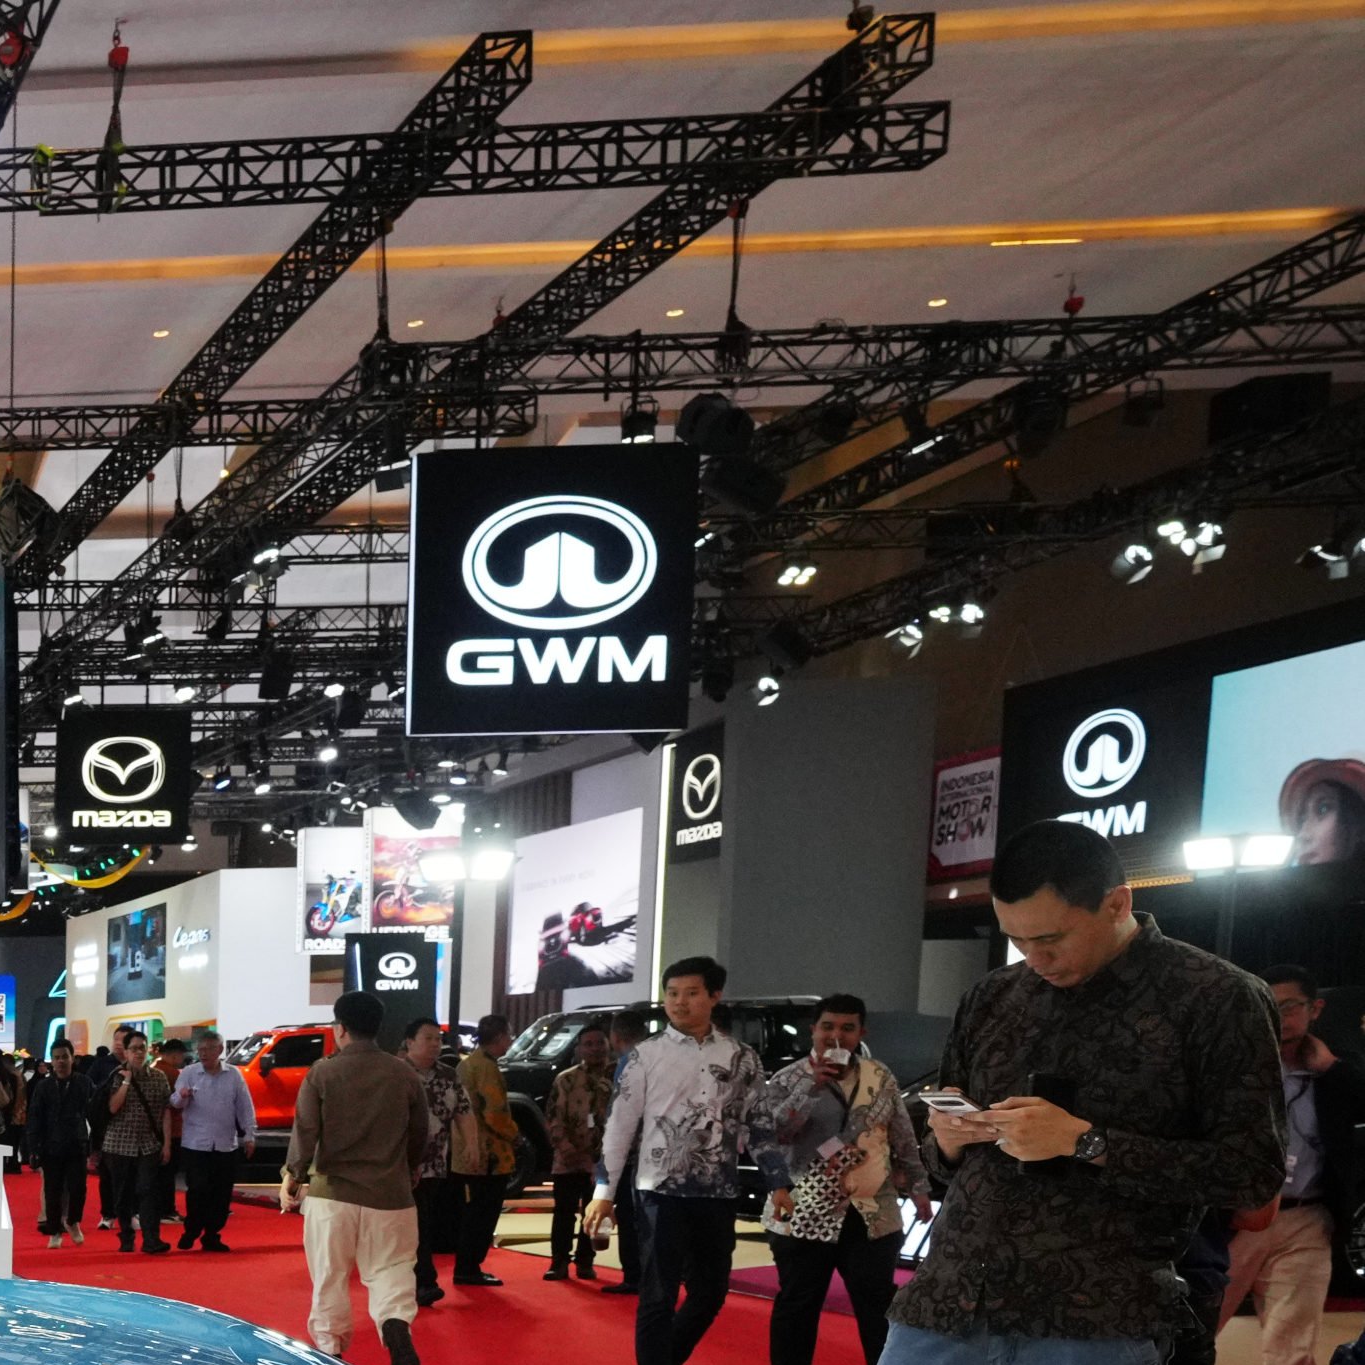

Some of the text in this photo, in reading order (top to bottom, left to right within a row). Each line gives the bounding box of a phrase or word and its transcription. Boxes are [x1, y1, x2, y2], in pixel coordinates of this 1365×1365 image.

[446, 635, 668, 686] GWM
[938, 795, 992, 823] MOTOR
[935, 817, 988, 846] SHOW
[375, 979, 419, 991] GWM
